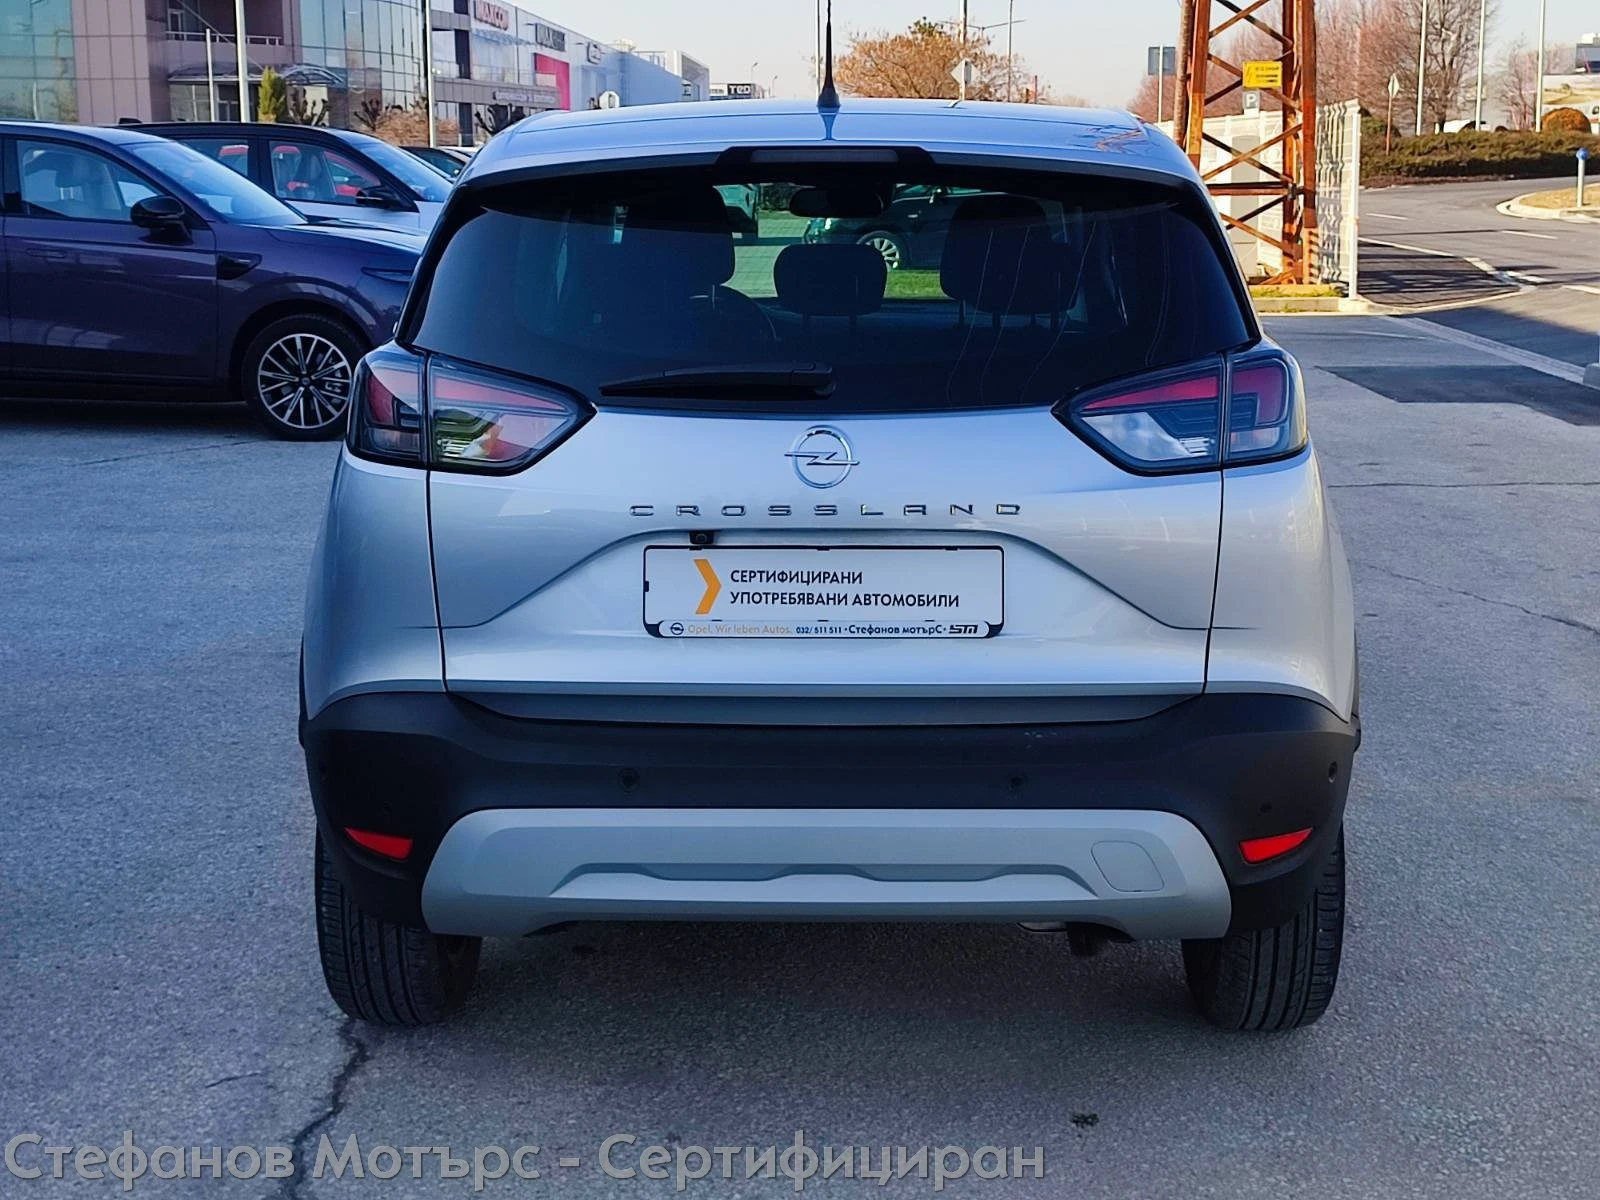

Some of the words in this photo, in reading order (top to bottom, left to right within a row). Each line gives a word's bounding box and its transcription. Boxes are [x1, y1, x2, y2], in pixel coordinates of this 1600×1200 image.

[1246, 93, 1258, 108] P
[629, 503, 1021, 517] CROSSLAND
[730, 569, 863, 586] СЕРТИФИЦИРАНИ
[730, 591, 848, 606] УПОТРЕБЯВАНИ
[852, 593, 960, 608] АВТОМОБИЛИ
[734, 624, 761, 634] leben
